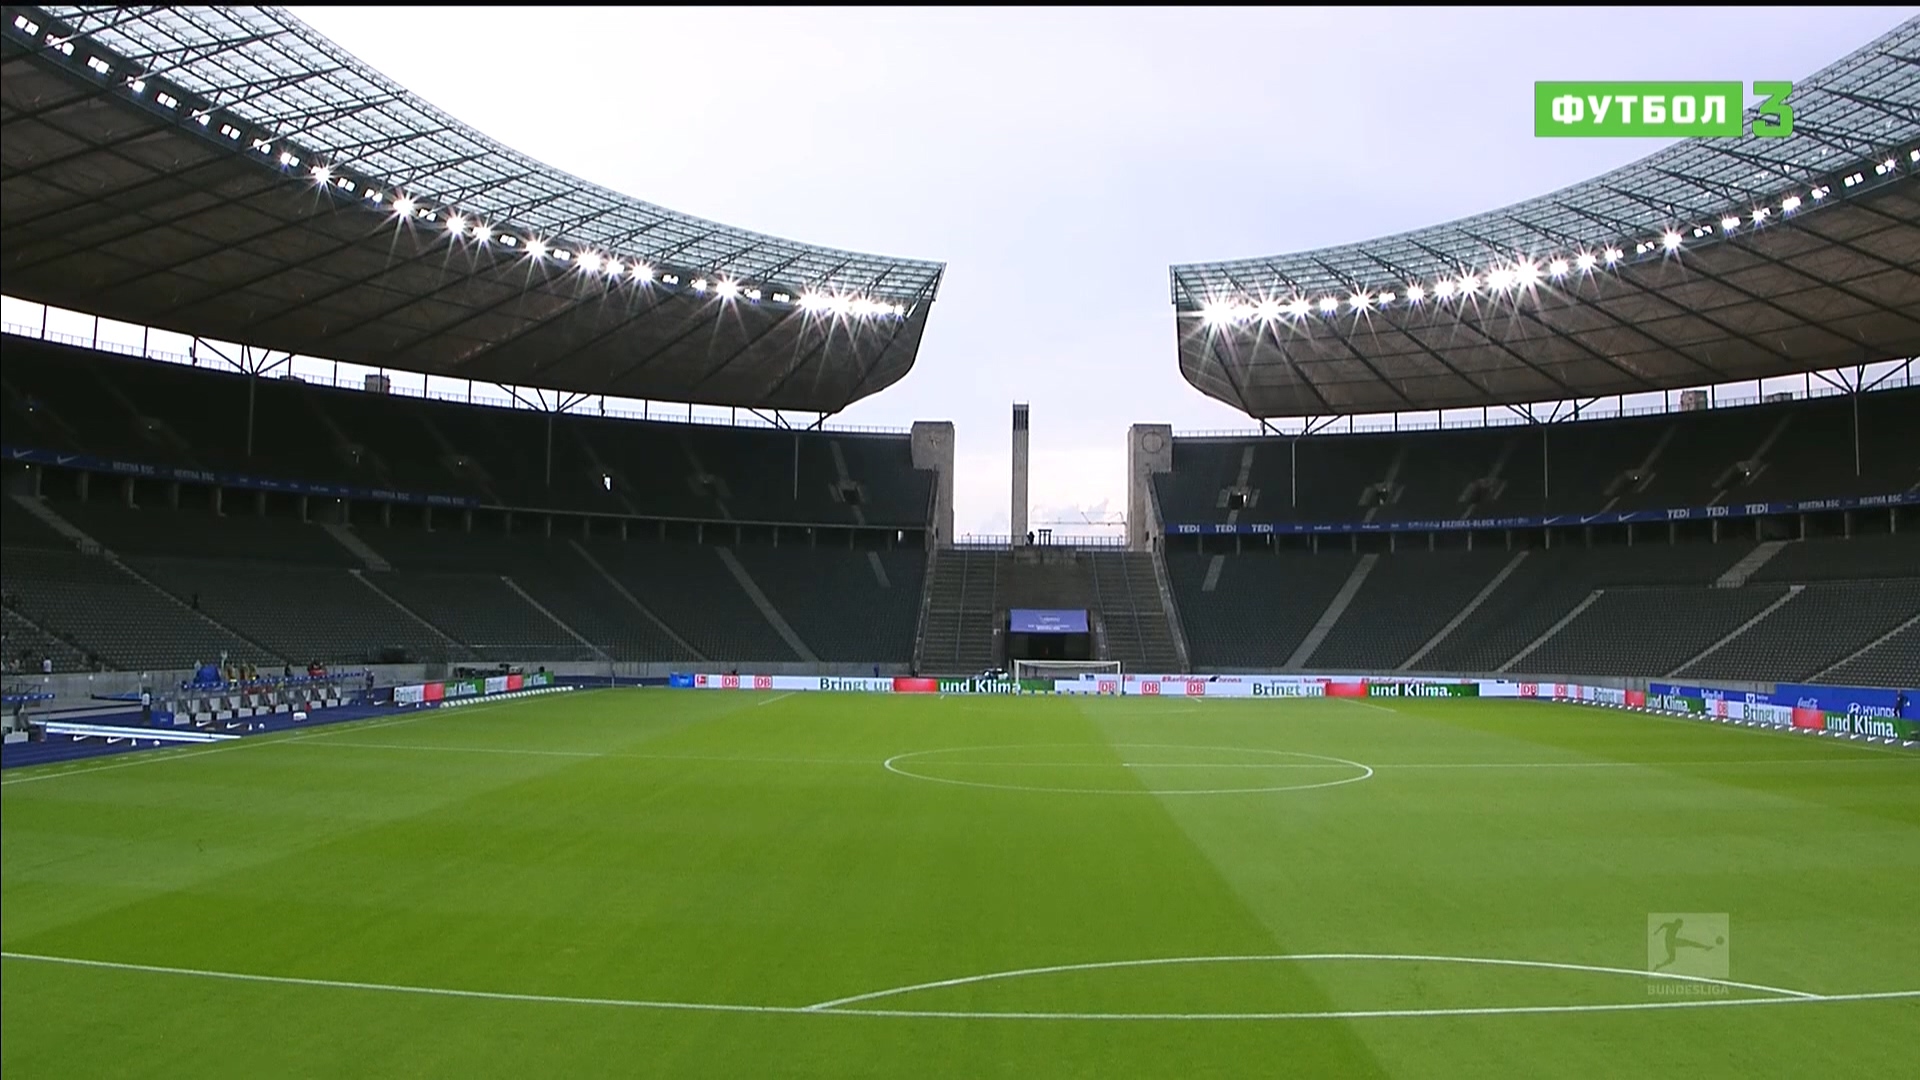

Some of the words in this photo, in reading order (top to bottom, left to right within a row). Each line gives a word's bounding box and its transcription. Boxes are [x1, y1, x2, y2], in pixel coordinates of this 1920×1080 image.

[820, 677, 868, 691] Bringt
[940, 679, 970, 693] und
[1253, 683, 1301, 697] Bringt
[1370, 683, 1399, 697] und
[1647, 694, 1662, 709] und
[1743, 704, 1775, 723] Bringt
[1827, 713, 1851, 732] und
[1854, 714, 1898, 738] Klima.
